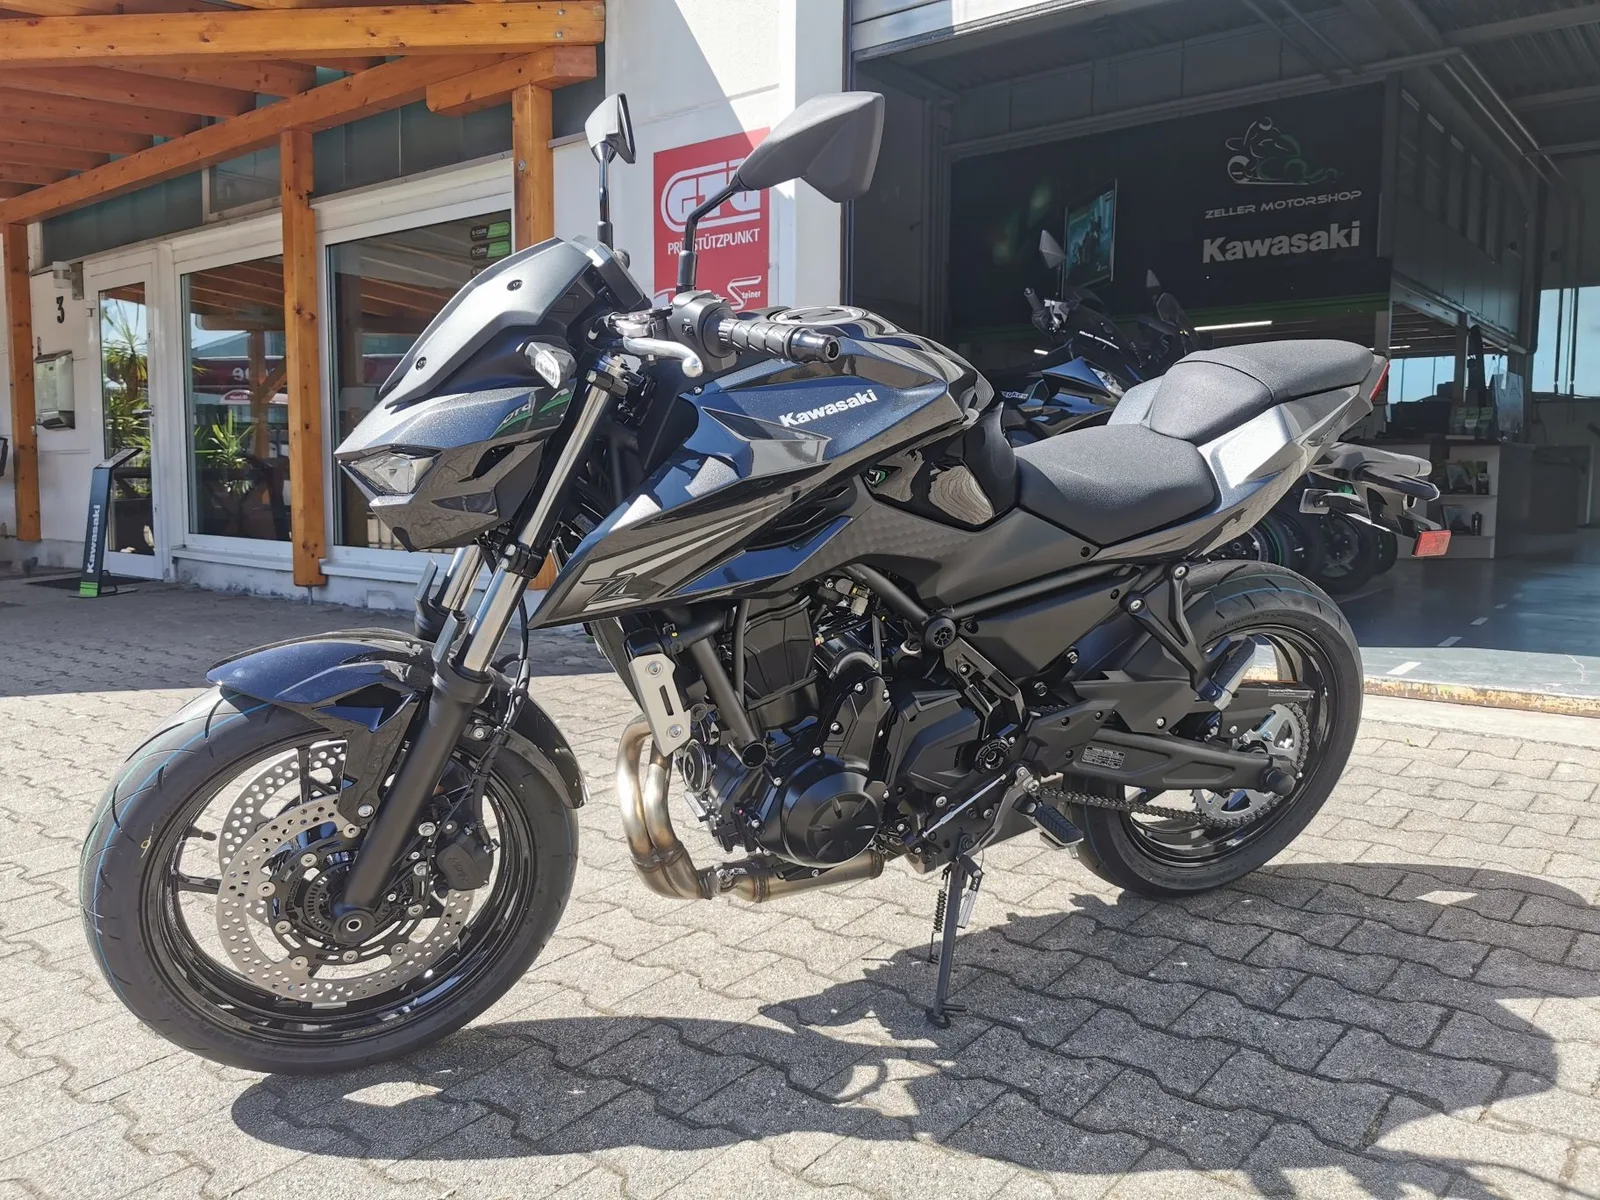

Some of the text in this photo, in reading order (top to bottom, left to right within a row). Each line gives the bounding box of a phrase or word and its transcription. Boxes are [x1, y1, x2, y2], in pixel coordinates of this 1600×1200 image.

[1205, 190, 1362, 220] ZELLER MOTORSHOP
[1202, 220, 1360, 264] Kawasaki
[56, 295, 65, 324] 3
[777, 388, 878, 428] Kawasaki
[86, 504, 101, 574] Kawasaki
